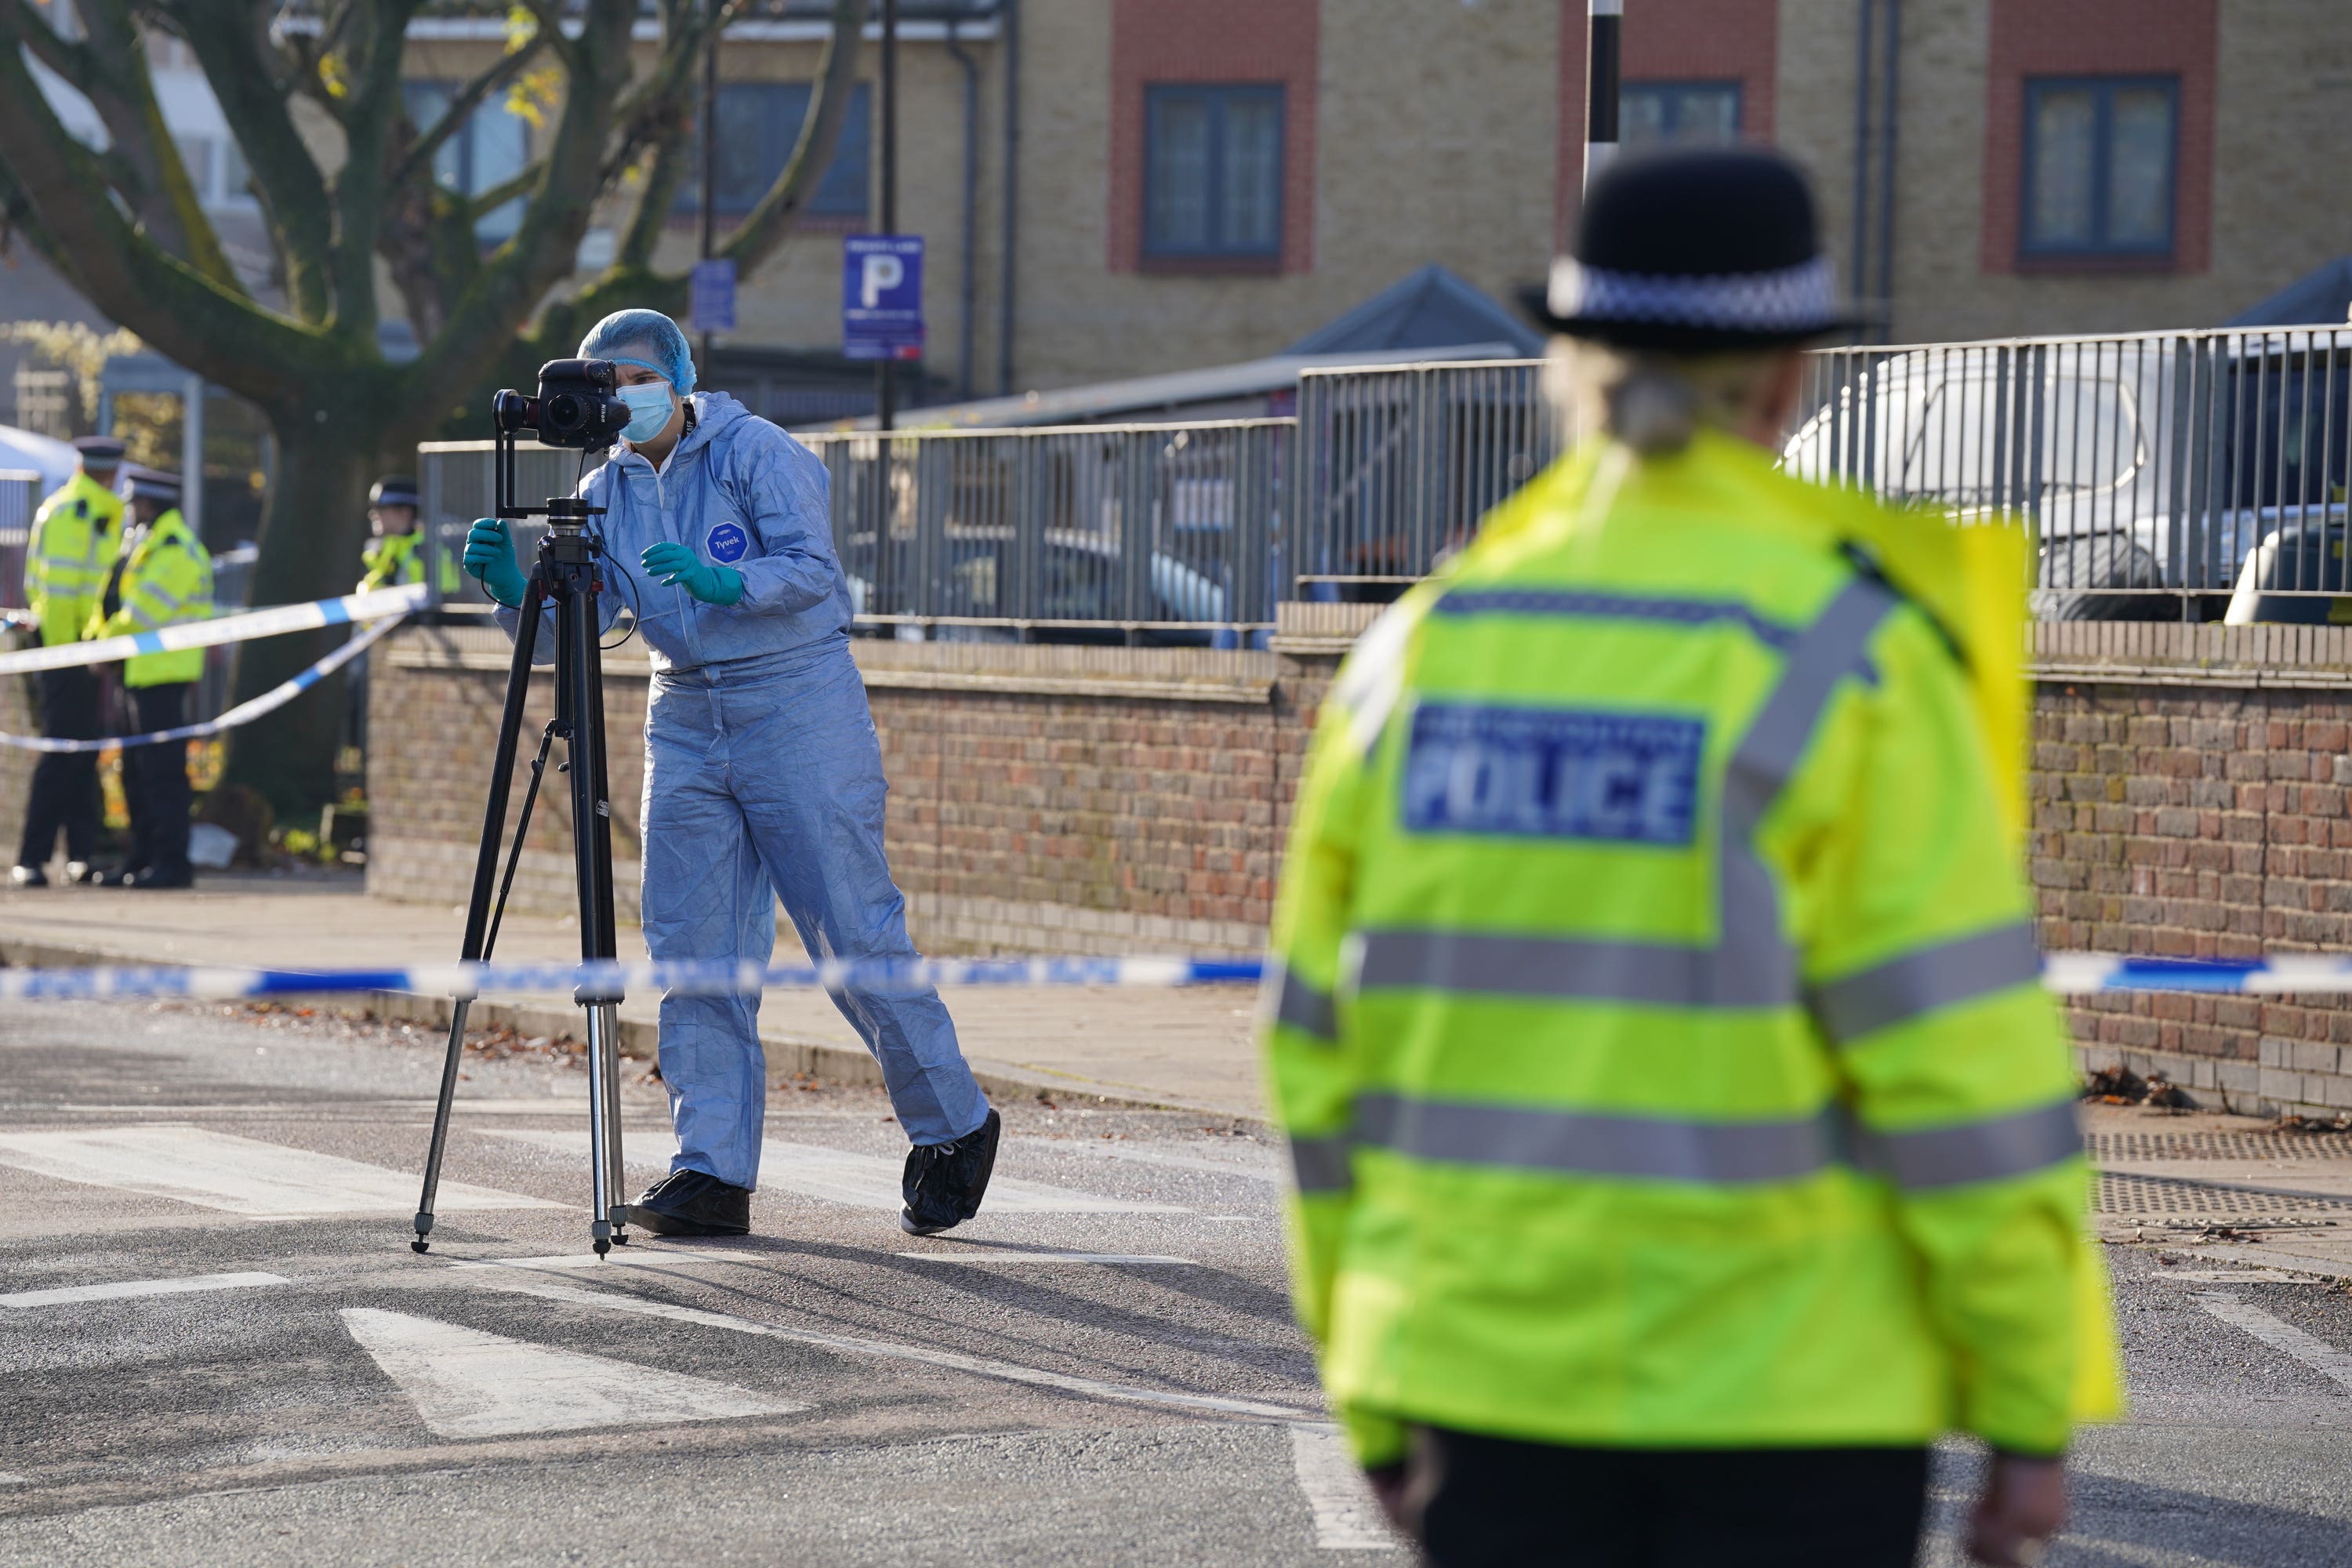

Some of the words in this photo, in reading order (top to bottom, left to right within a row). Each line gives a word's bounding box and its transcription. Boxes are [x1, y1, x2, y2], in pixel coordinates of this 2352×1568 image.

[862, 254, 905, 307] P
[714, 535, 740, 550] Tyvek
[1410, 735, 1693, 836] POLICE
